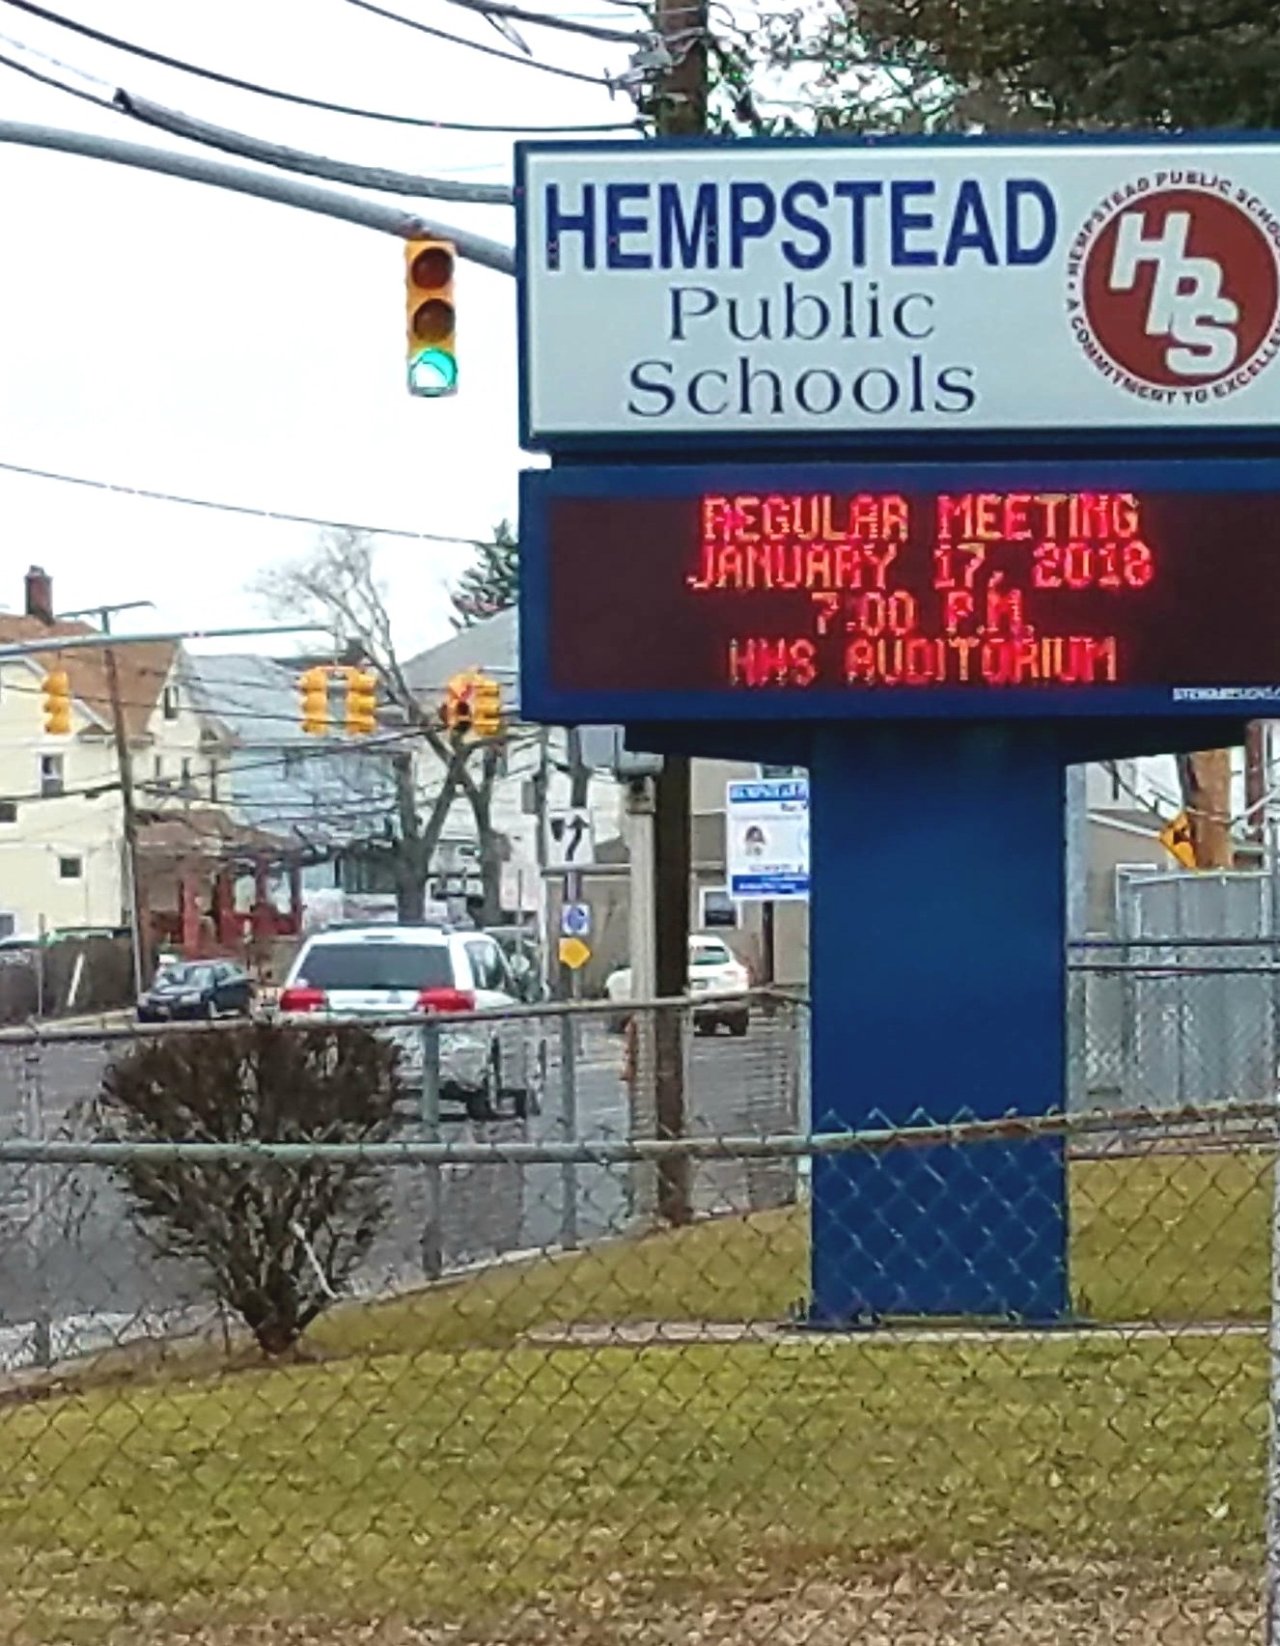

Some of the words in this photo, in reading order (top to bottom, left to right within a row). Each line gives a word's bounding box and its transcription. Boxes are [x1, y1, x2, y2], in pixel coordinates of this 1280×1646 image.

[545, 180, 1058, 269] HEMPSTEAD
[1067, 178, 1150, 275] HEMPSTEAD
[1156, 170, 1232, 195] PUBLIC
[668, 282, 937, 342] Public
[628, 355, 977, 418] Schools
[1071, 316, 1178, 404] COMMITMENT
[1182, 389, 1208, 405] TO
[702, 494, 910, 543] REGULAR
[937, 492, 1141, 541] MEETING
[685, 543, 898, 590] JANUARY
[934, 542, 1004, 590] 17,
[1032, 540, 1154, 588] 2018
[843, 636, 1118, 686] AUDITORIUM
